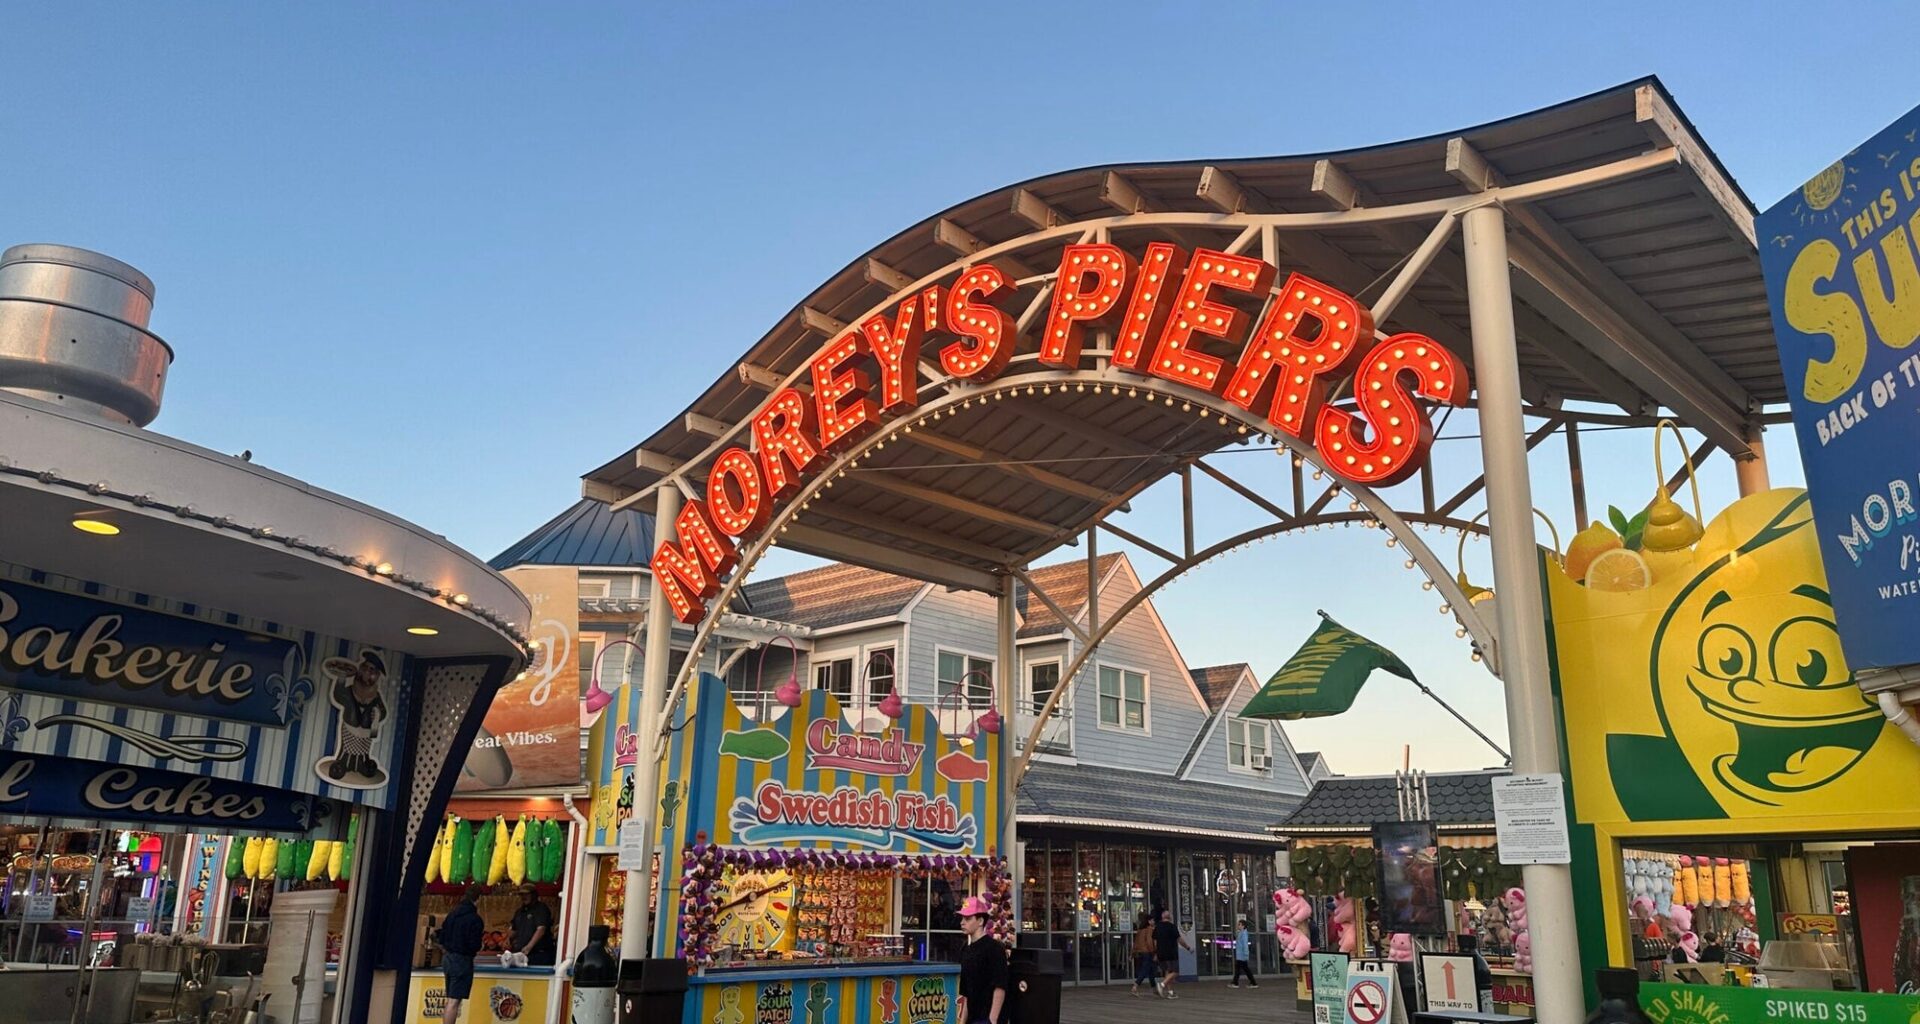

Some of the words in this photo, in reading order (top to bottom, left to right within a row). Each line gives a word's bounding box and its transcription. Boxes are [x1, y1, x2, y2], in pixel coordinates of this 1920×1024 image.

[1841, 189, 1897, 249] THIS
[1784, 208, 1920, 404] SU
[651, 263, 1014, 623] MOREY'S
[1039, 243, 1466, 487] PIERS
[1816, 392, 1868, 447] BACK
[1871, 371, 1896, 413] OF
[1838, 473, 1920, 563] MOR
[506, 730, 557, 748] Vibes.
[808, 718, 924, 775] Candy
[85, 768, 265, 819] Cakes
[758, 782, 892, 829] Swedish
[895, 793, 957, 832] Fish
[760, 995, 790, 1008] SOUR
[910, 994, 948, 1014] PATCH
[914, 978, 944, 997] SOUR
[1429, 1000, 1446, 1008] THIS
[1447, 1001, 1462, 1009] WAY
[1766, 999, 1829, 1020] SPIKED
[1835, 1002, 1867, 1022] $15
[759, 1007, 791, 1022] PATCH
